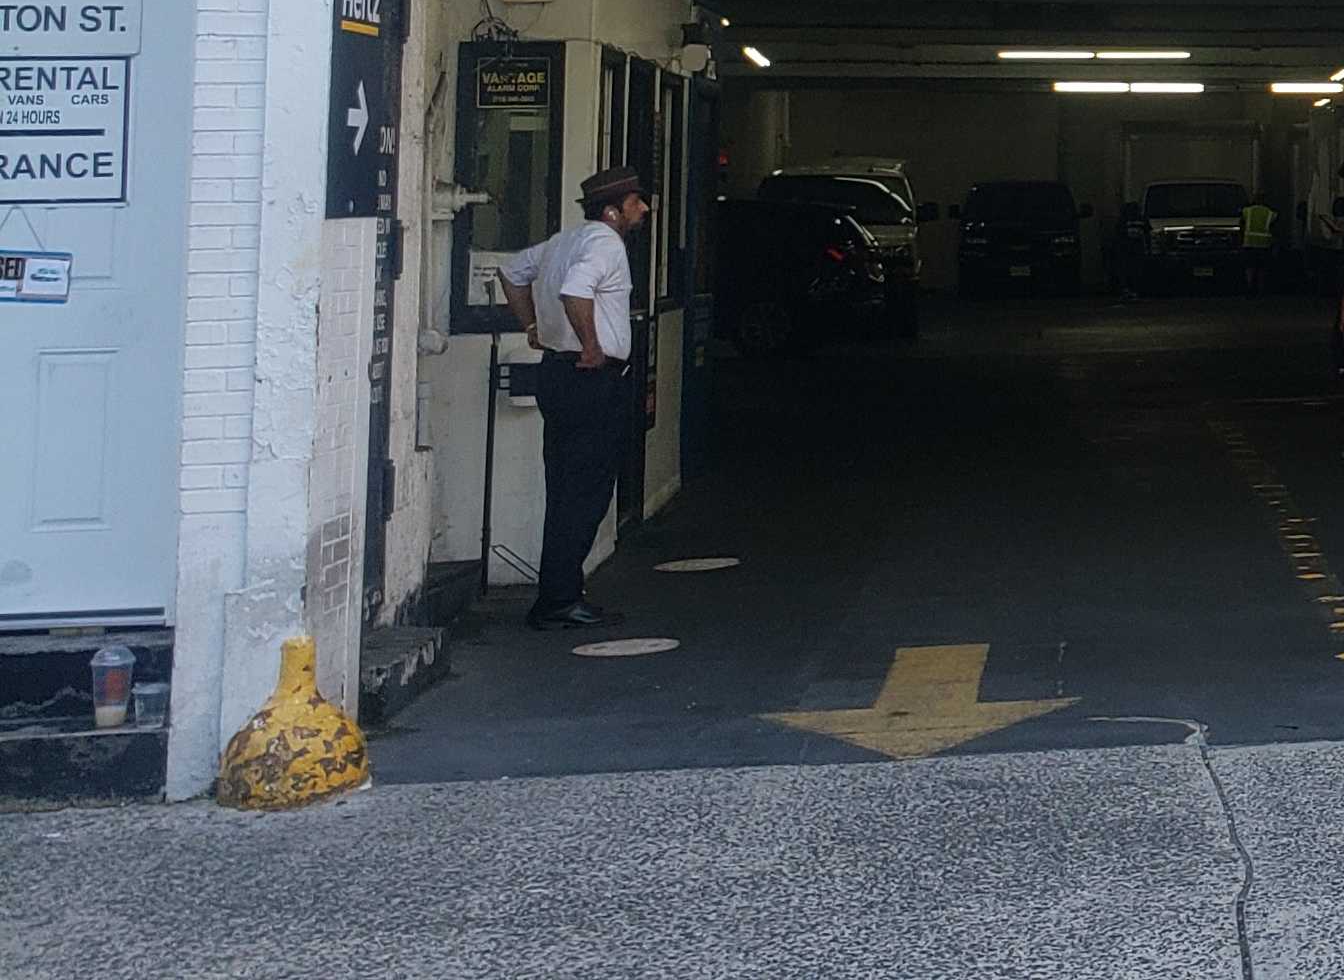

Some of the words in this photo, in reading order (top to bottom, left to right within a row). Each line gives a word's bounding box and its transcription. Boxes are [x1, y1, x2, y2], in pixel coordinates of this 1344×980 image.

[80, 5, 126, 32] ST.
[0, 67, 119, 90] RENTAL
[8, 95, 44, 105] VANS
[71, 94, 109, 105] CARS
[6, 110, 18, 124] 24
[22, 110, 60, 124] HOURS
